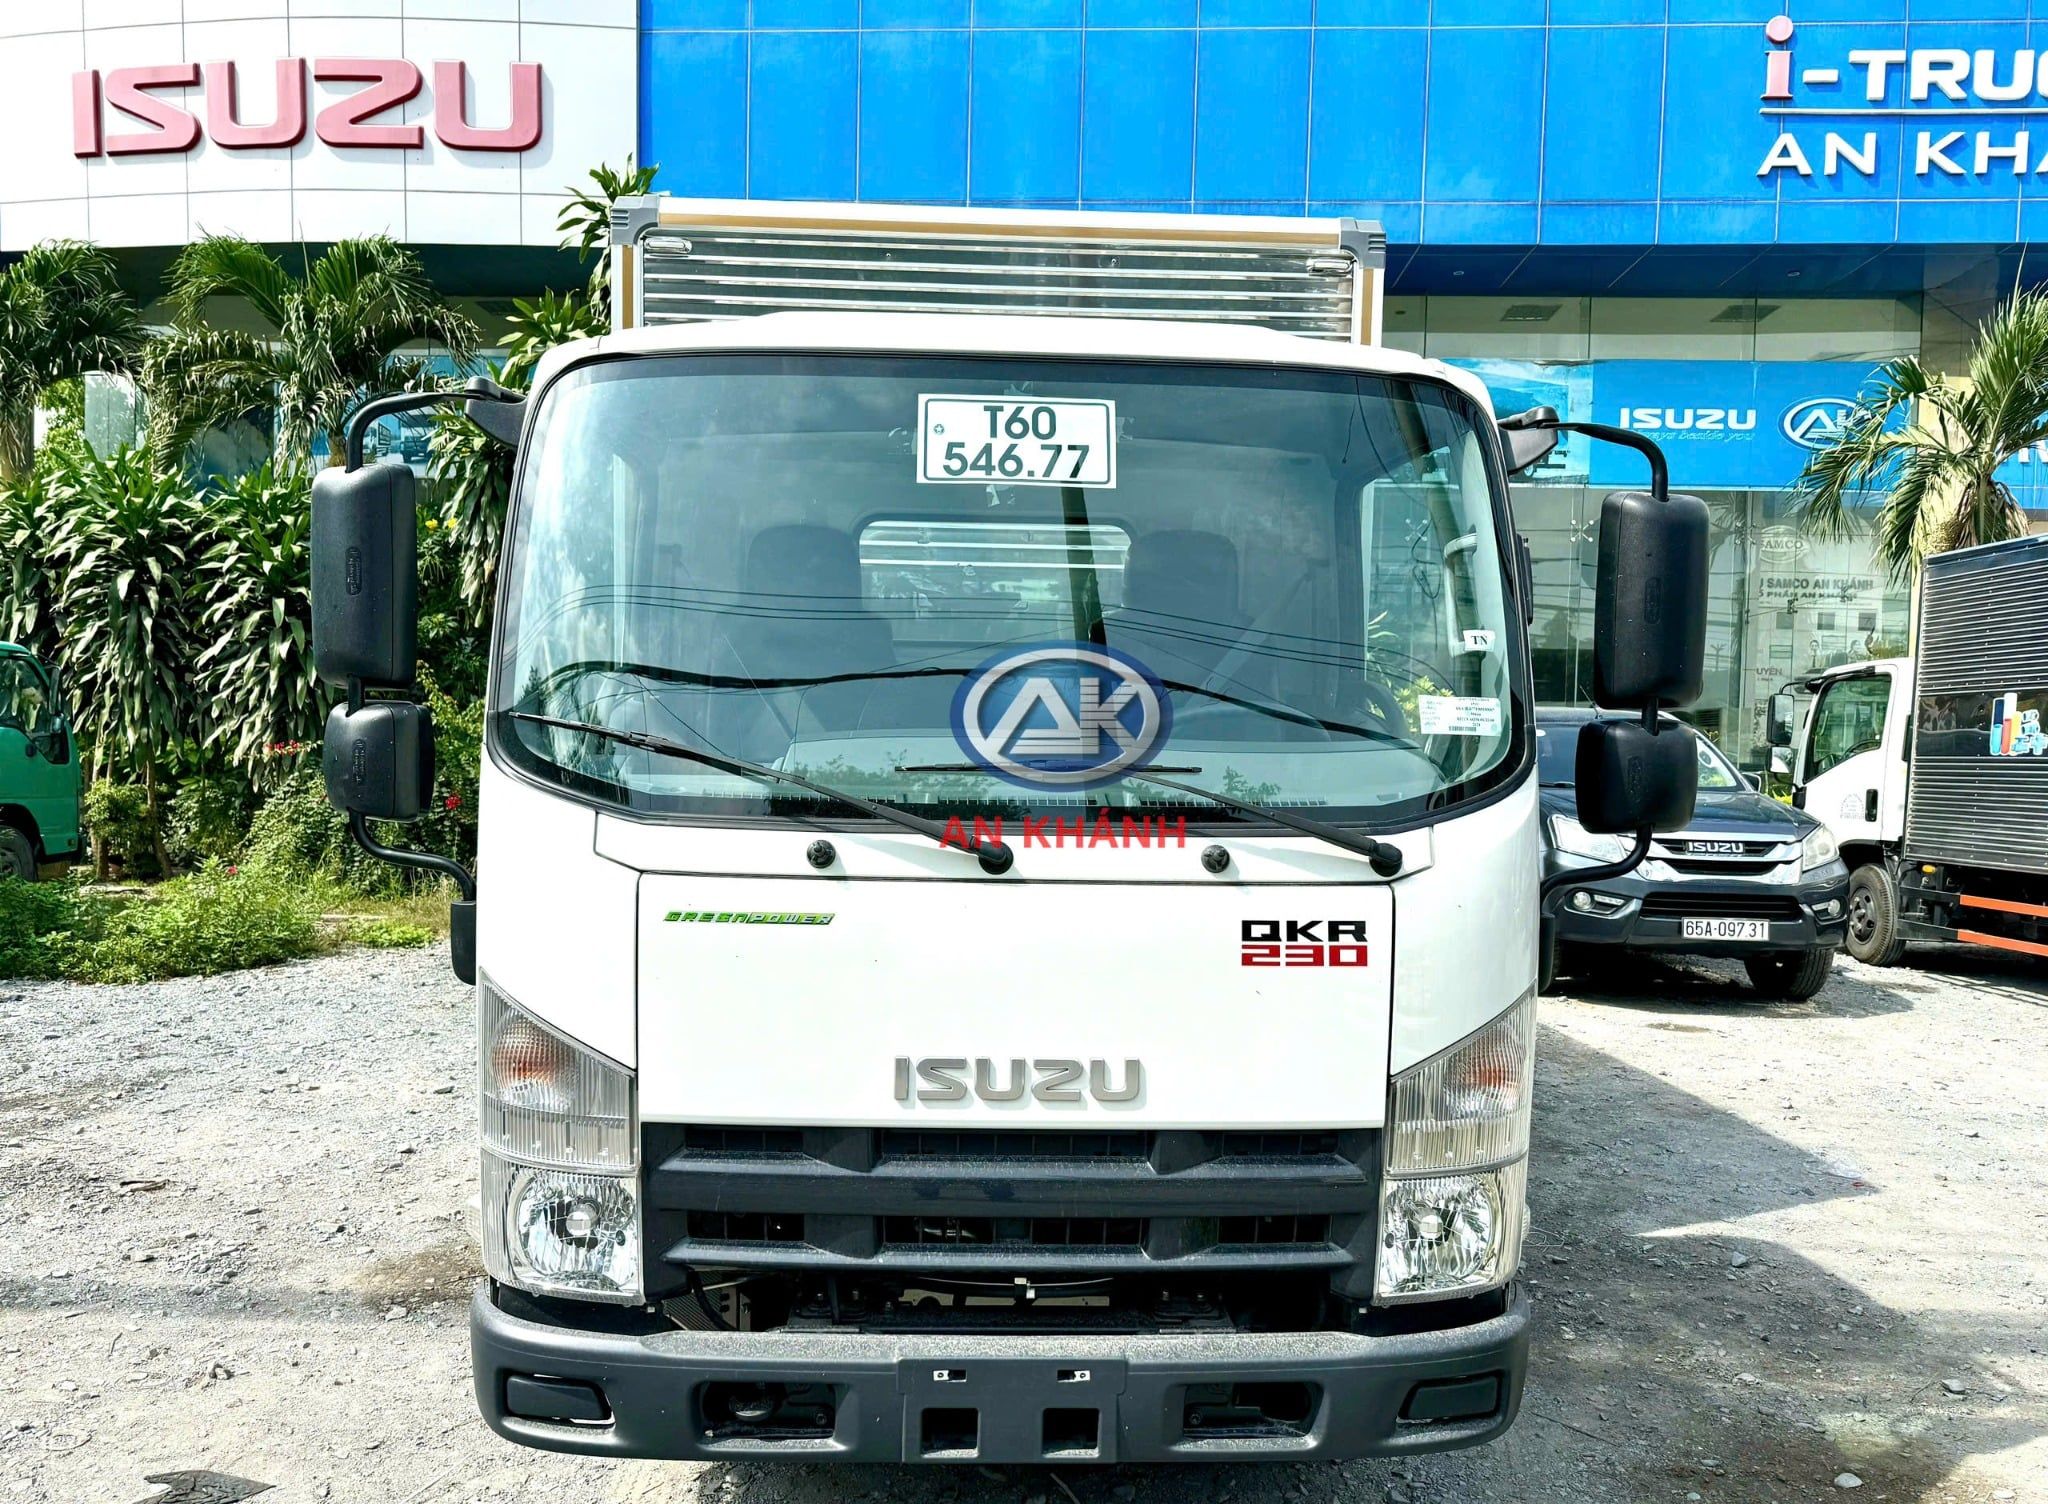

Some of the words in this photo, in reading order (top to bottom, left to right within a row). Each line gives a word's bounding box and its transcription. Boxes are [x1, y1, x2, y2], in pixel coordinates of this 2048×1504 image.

[1760, 15, 2048, 101] i-TRU
[72, 56, 544, 158] ISUZU
[1756, 132, 1877, 176] AN
[1915, 131, 2048, 175] KH
[983, 405, 1057, 440] T60
[1619, 407, 1757, 431] ISUZU
[942, 441, 1091, 479] 546.77
[1767, 578, 1809, 589] SAMCO
[1813, 579, 1830, 590] AN
[1687, 841, 1744, 853] ISUZU
[1241, 919, 1368, 942] QKR
[1241, 944, 1368, 967] 230
[894, 1056, 1141, 1102] ISUZU
